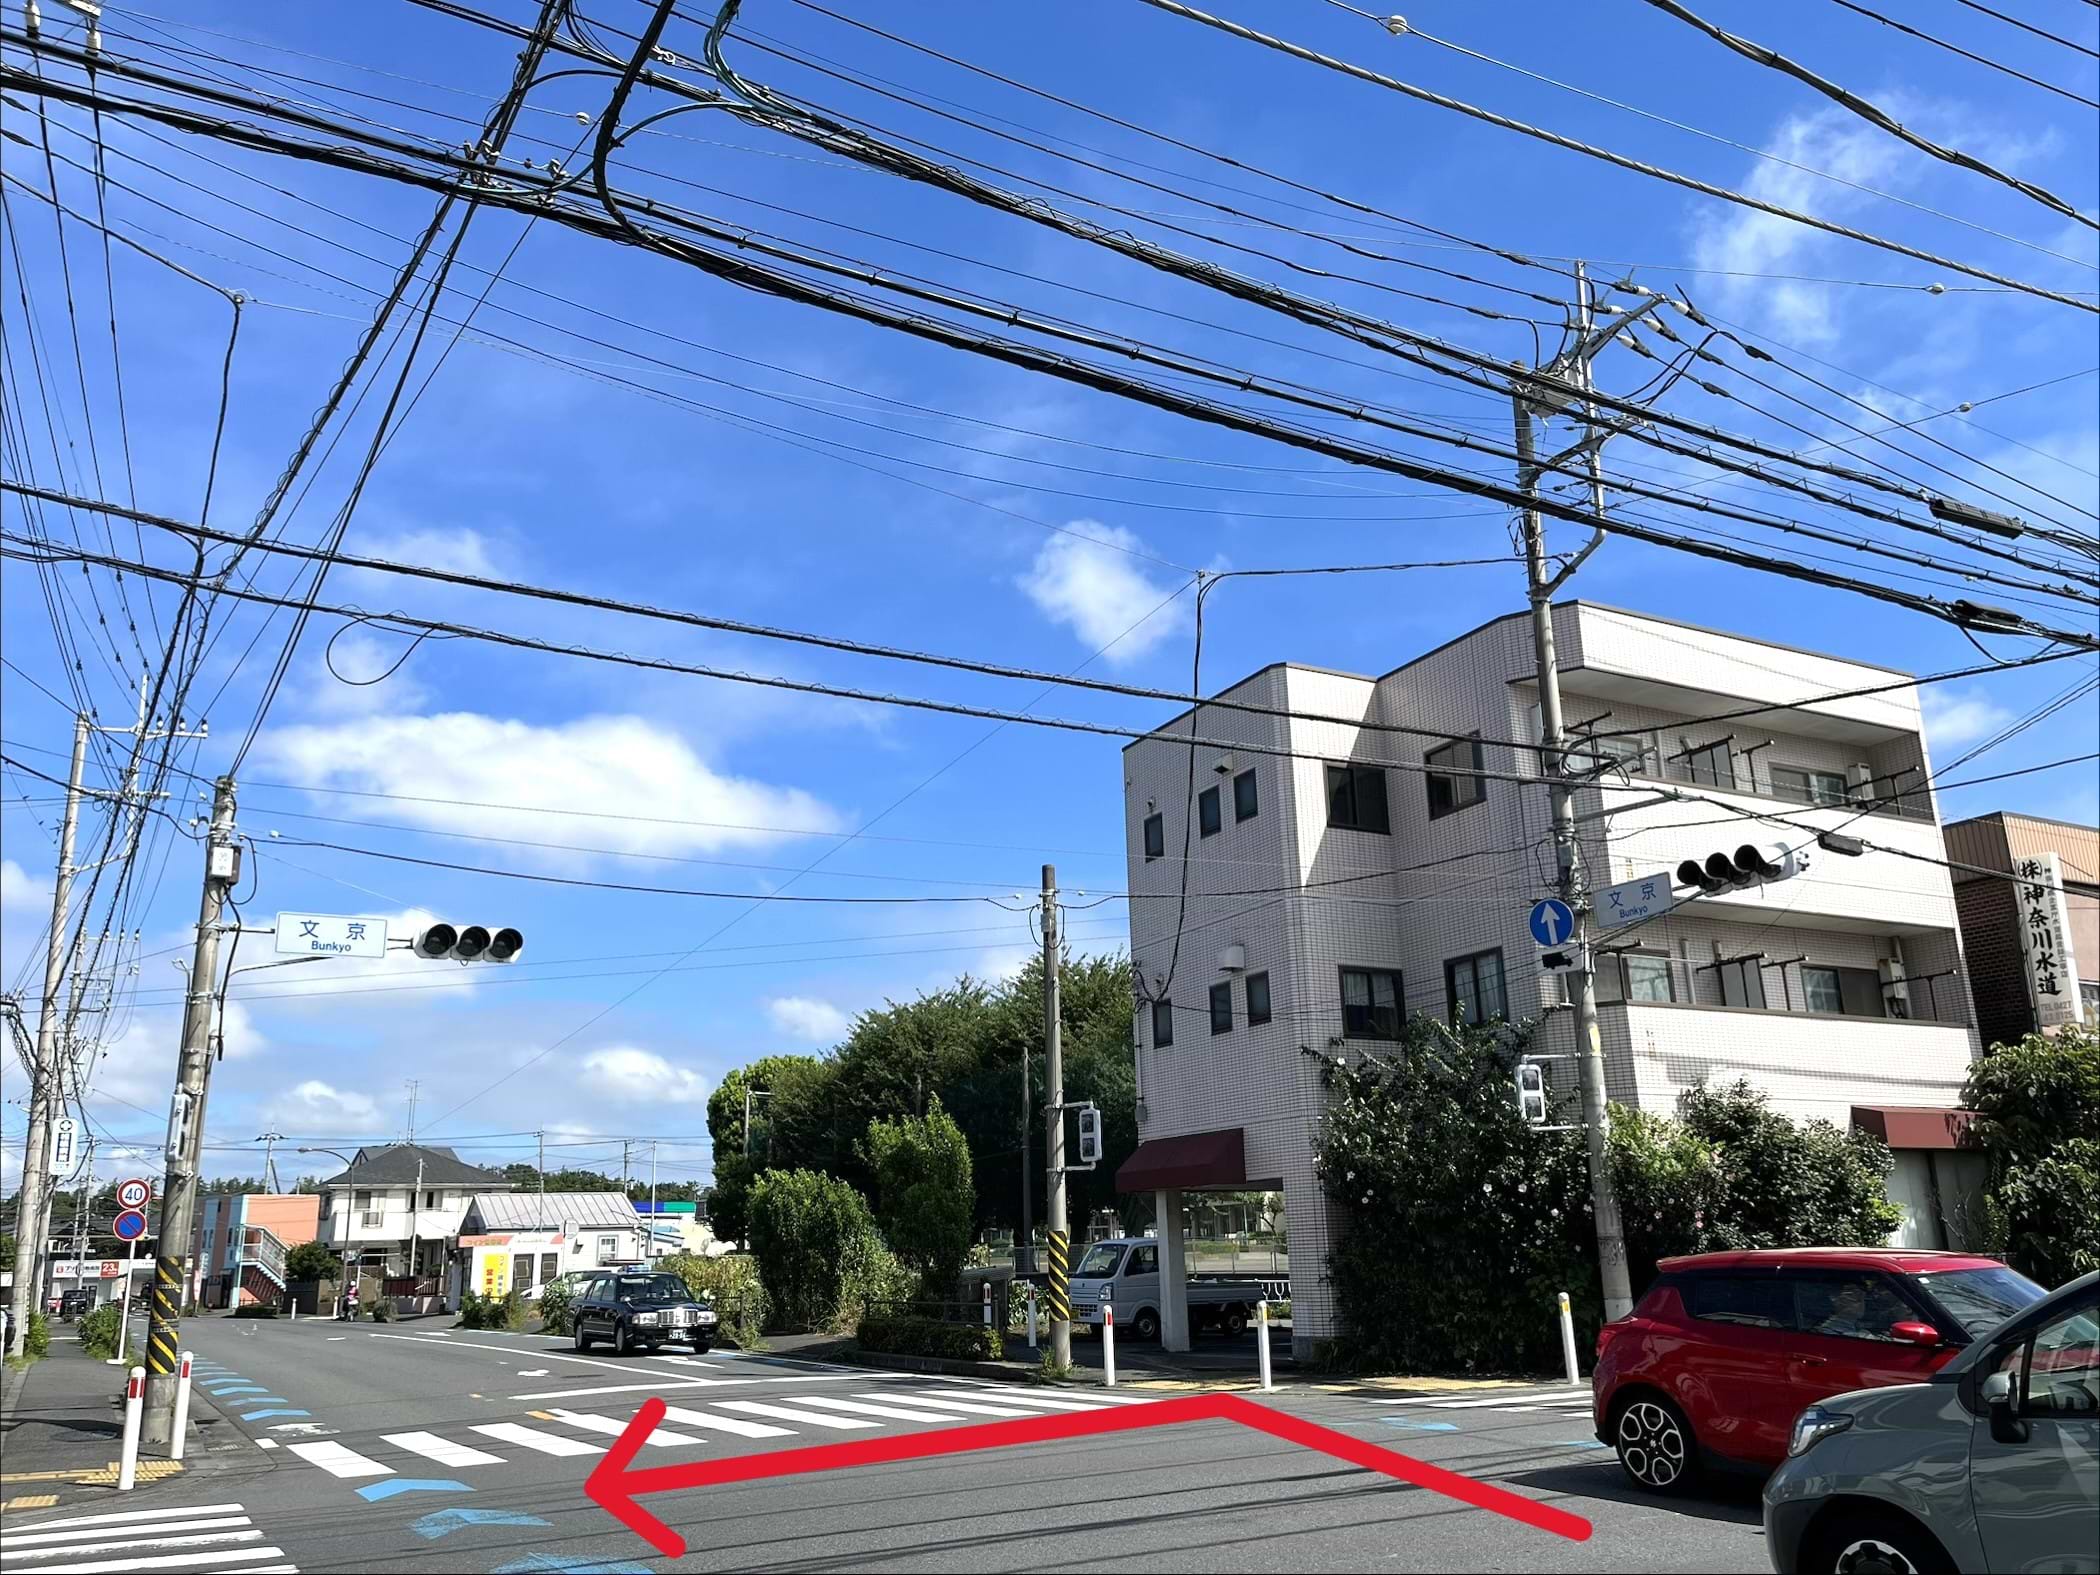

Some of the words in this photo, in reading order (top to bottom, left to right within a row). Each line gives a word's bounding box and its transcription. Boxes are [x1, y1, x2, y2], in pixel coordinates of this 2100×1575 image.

[1619, 906, 1648, 918] Bunkyo
[311, 940, 351, 953] Bunkyo
[125, 1188, 143, 1201] 40
